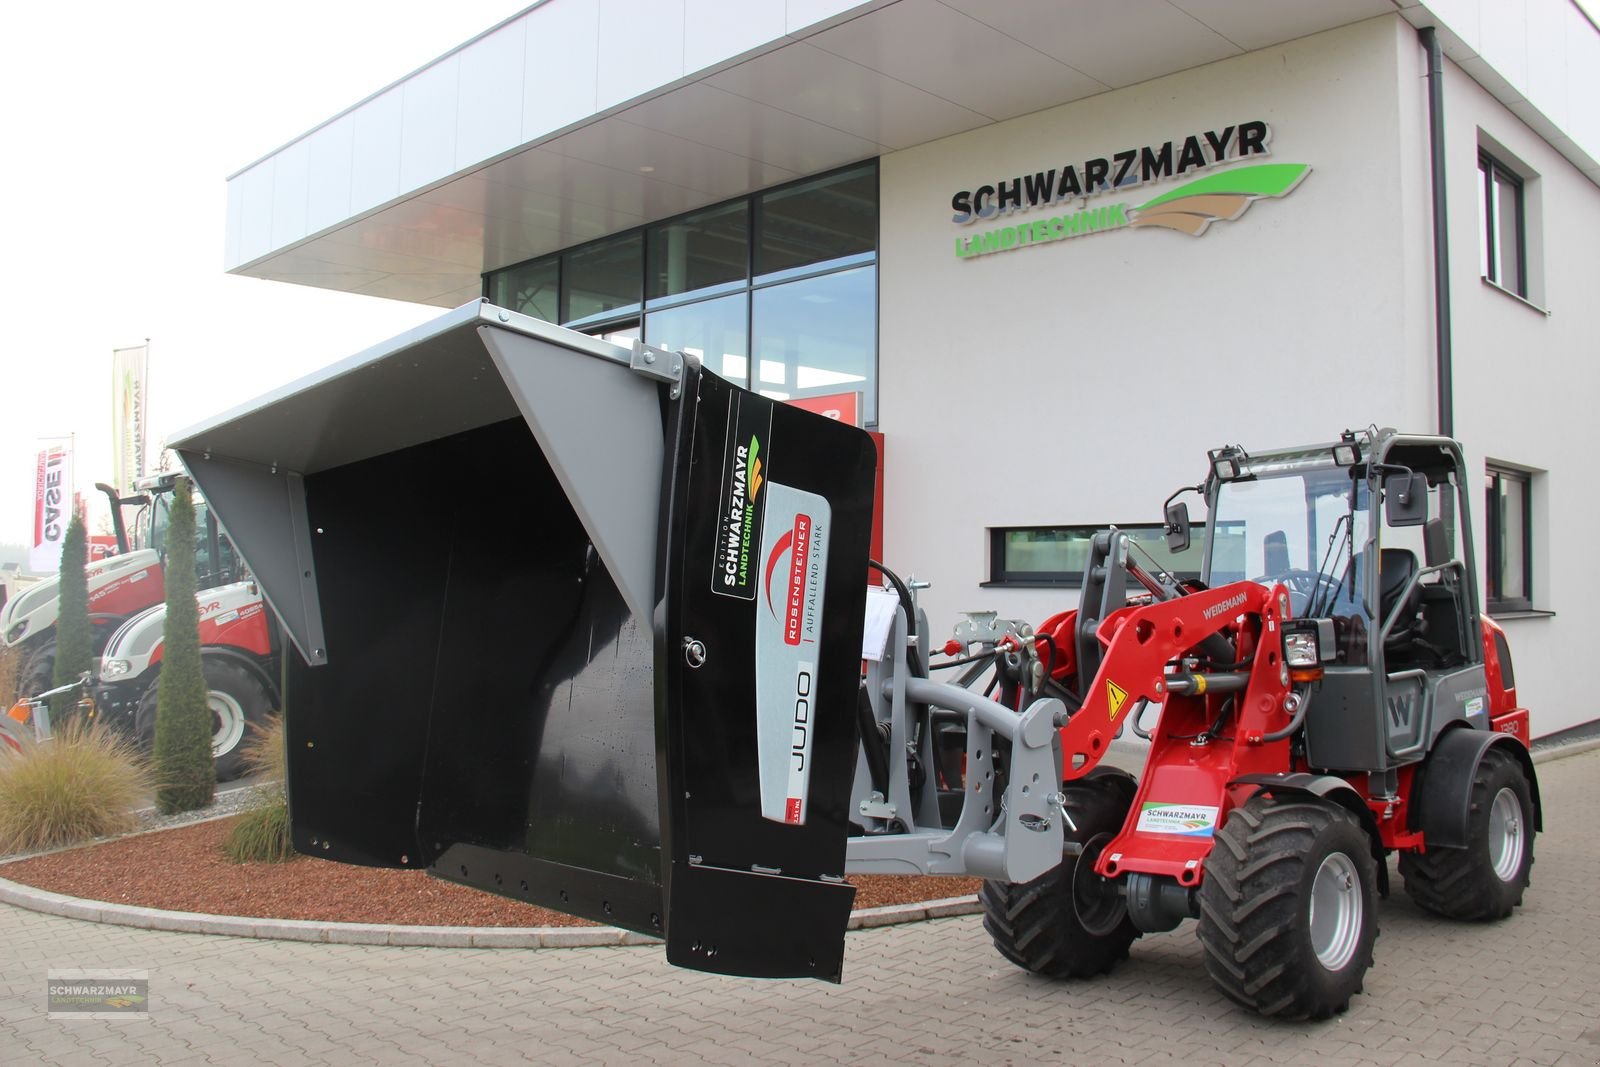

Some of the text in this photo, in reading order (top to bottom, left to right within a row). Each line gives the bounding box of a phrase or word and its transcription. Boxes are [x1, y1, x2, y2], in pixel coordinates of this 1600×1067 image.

[951, 120, 1268, 224] SCHWARZMAYR
[955, 203, 1129, 257] LANDTECHNIK
[719, 516, 729, 568] EDITION
[724, 445, 748, 587] SCHWARZMAYR
[738, 504, 754, 586] LANDTECHNIK
[789, 521, 807, 640] ROSENSTEINER
[806, 524, 824, 633] AUFFALLEND STARK
[1203, 592, 1248, 620] WEIDEMANN
[792, 672, 811, 772] JUDO
[1147, 809, 1207, 820] SCHWARZMAYR
